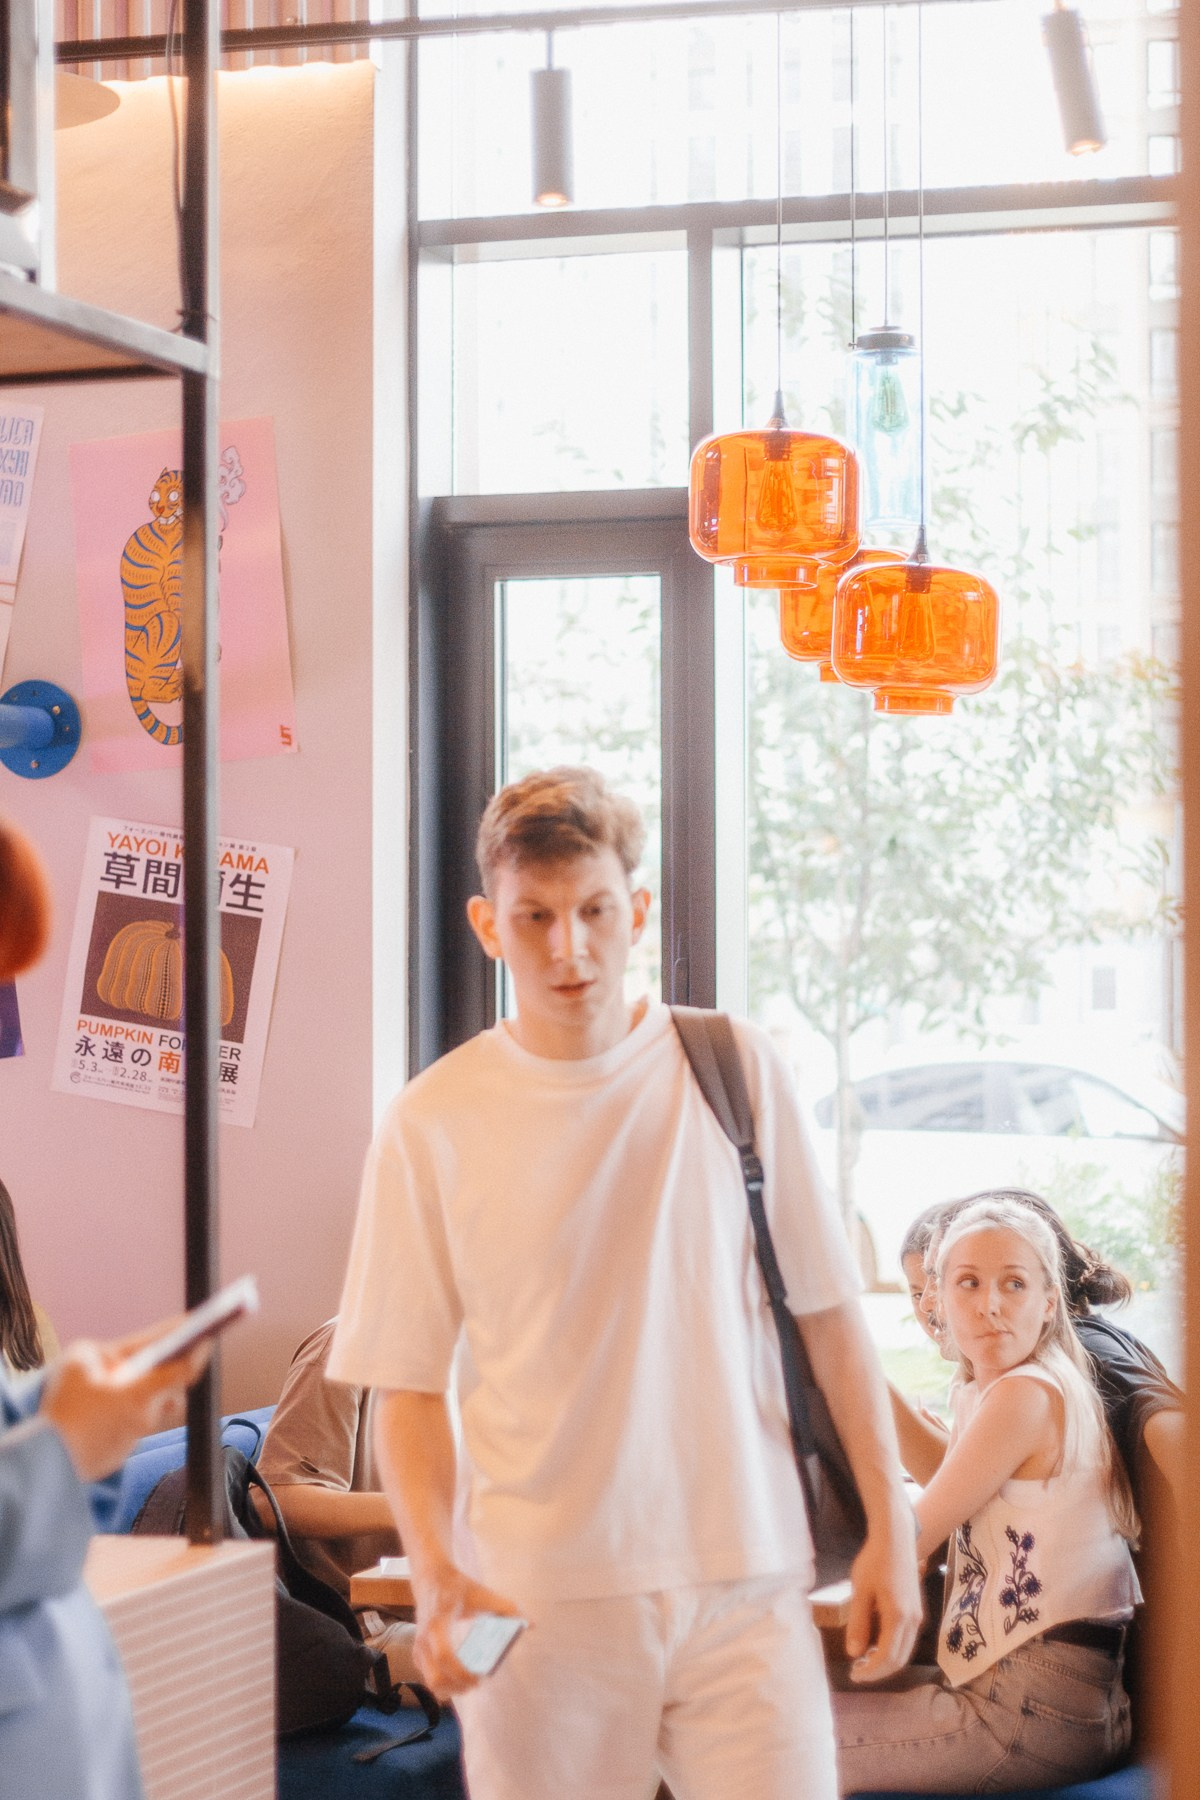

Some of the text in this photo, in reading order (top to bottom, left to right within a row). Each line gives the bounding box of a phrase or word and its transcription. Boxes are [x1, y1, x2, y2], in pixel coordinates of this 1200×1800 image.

[107, 832, 167, 857] YAYOI
[174, 844, 269, 874] KAMA
[100, 851, 266, 913] 草間生
[77, 1020, 241, 1061] PUMPKIN FOER
